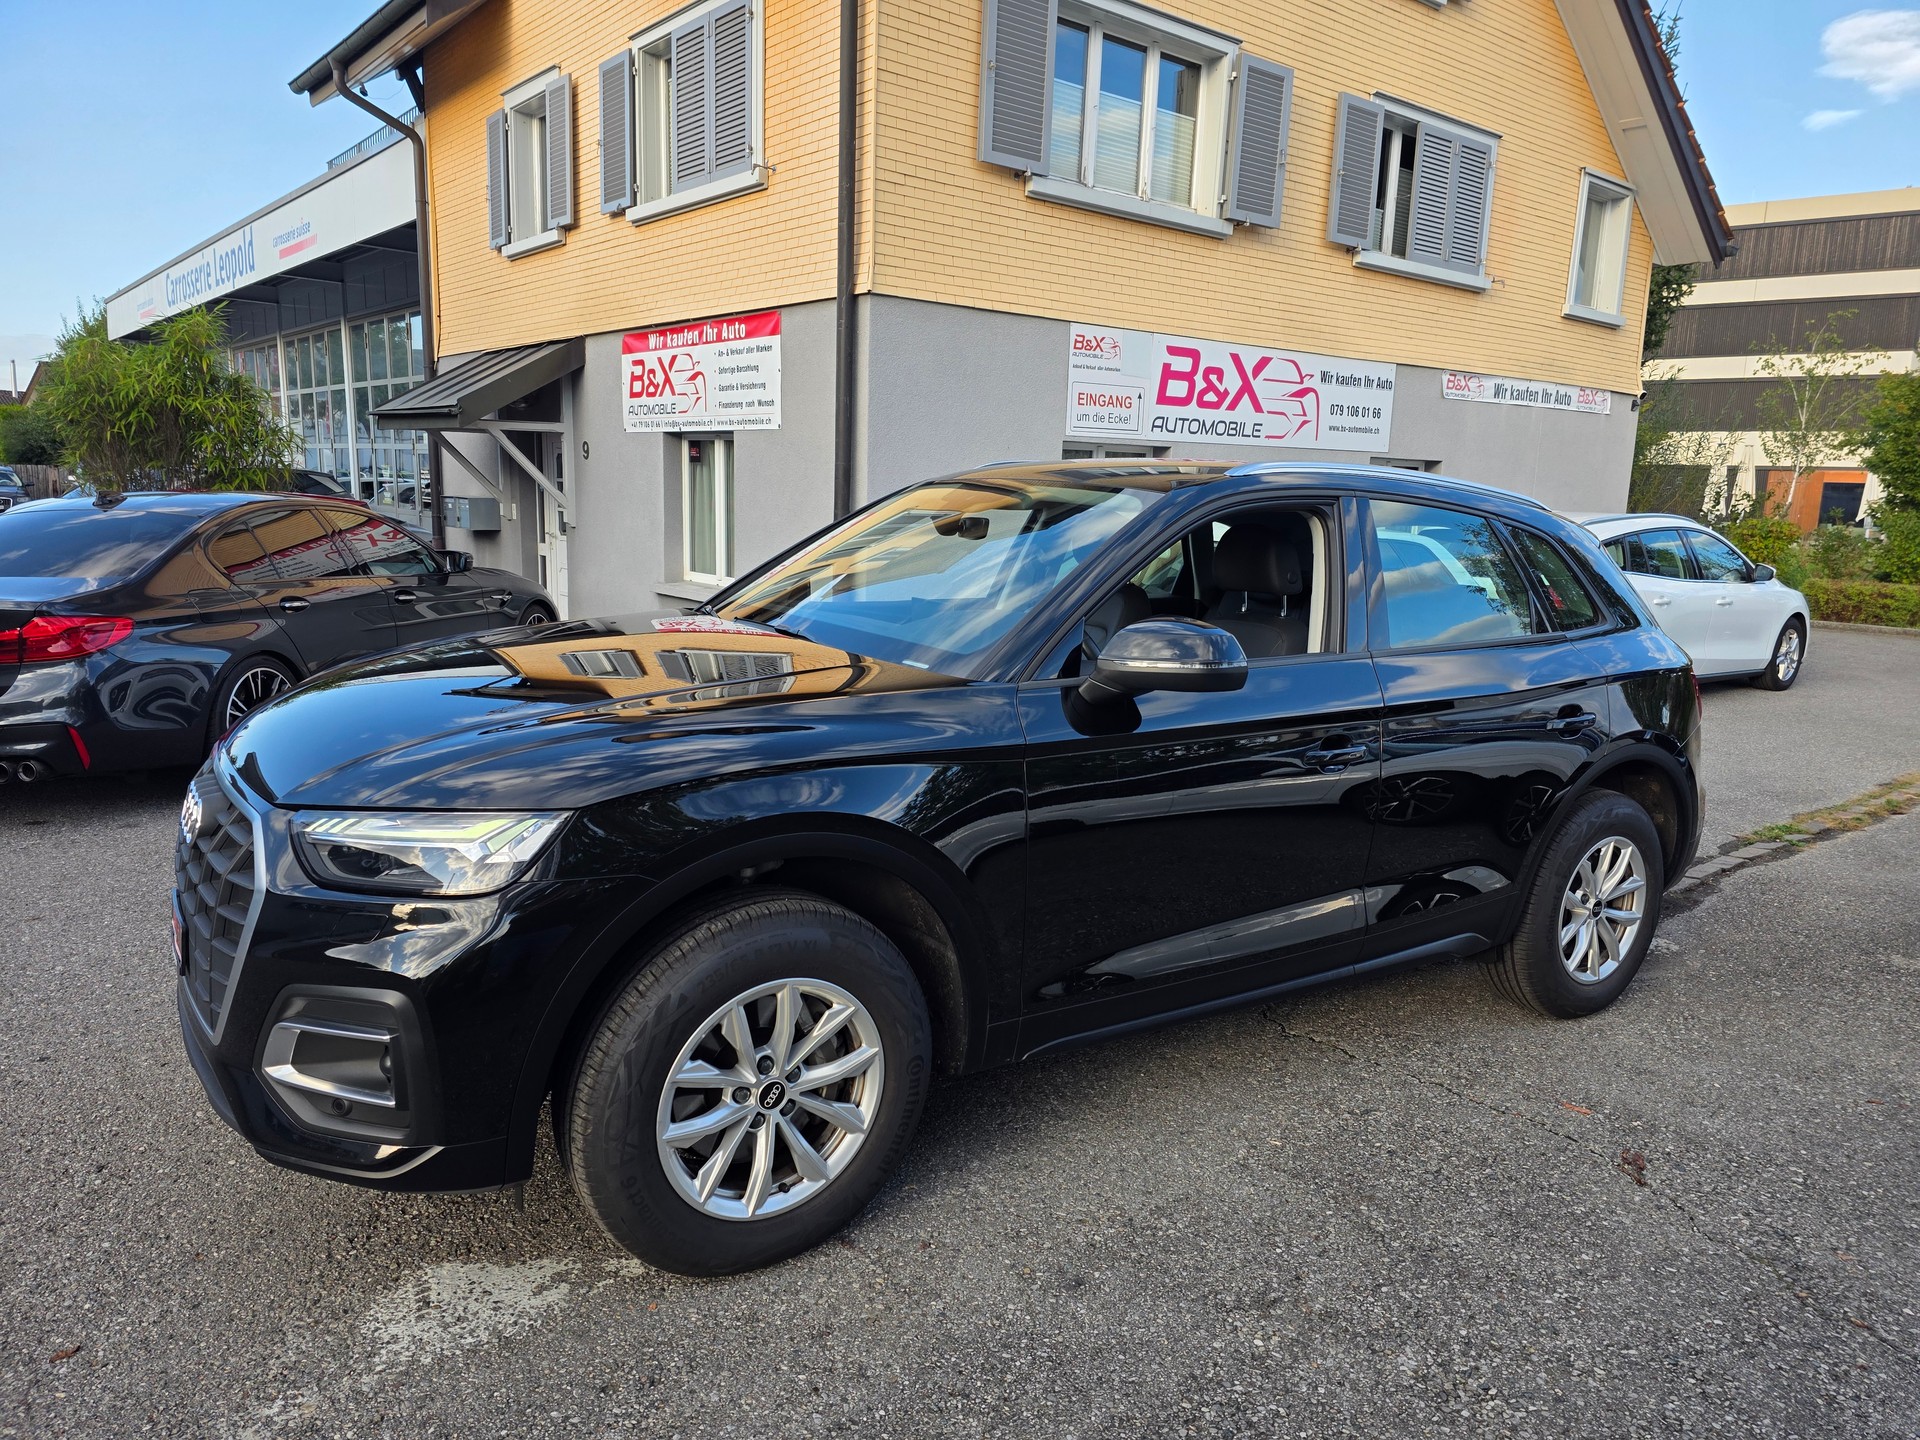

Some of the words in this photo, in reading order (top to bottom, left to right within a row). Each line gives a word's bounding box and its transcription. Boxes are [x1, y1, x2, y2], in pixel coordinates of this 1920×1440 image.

[272, 226, 297, 248] carrosserie
[296, 218, 311, 238] suisse
[165, 253, 212, 308] Carrosserie
[213, 225, 256, 289] Leopold
[647, 334, 664, 350] Wir
[666, 329, 700, 348] kaufen
[703, 325, 718, 342] Ihr
[721, 322, 746, 340] Auto
[1073, 334, 1106, 352] B&X
[730, 347, 745, 356] Verkauf
[756, 344, 772, 353] Marken
[1072, 351, 1104, 359] AUTOMOBILE
[629, 354, 679, 399] B&X
[718, 365, 736, 375] Sofortige
[736, 364, 760, 373] Barzahlung
[718, 383, 735, 392] Garantie
[740, 382, 766, 390] Versicherung
[1155, 345, 1274, 414] B&X
[1320, 370, 1334, 384] Wir
[1335, 372, 1362, 387] kaufen
[1363, 375, 1375, 388] Ihr
[1375, 376, 1393, 390] Auto
[1445, 373, 1473, 392] B&X
[1077, 392, 1133, 409] EINGANG
[1493, 382, 1508, 400] Wir
[1509, 384, 1539, 403] kaufen
[1541, 388, 1553, 404] Ihr
[1553, 389, 1572, 406] Auto
[1577, 386, 1599, 406] B&X
[628, 402, 677, 416] AUTOMOBILE
[718, 401, 743, 409] Finanzierung
[757, 399, 775, 407] Wunsch
[1329, 403, 1344, 416] 079
[1346, 405, 1360, 418] 106
[1361, 406, 1371, 418] 01
[1372, 407, 1382, 419] 66
[1076, 413, 1090, 423] um
[1092, 412, 1106, 423] die
[1107, 412, 1132, 425] Ecke!
[1151, 416, 1263, 439] AUTOMOBILE
[582, 440, 590, 460] 9
